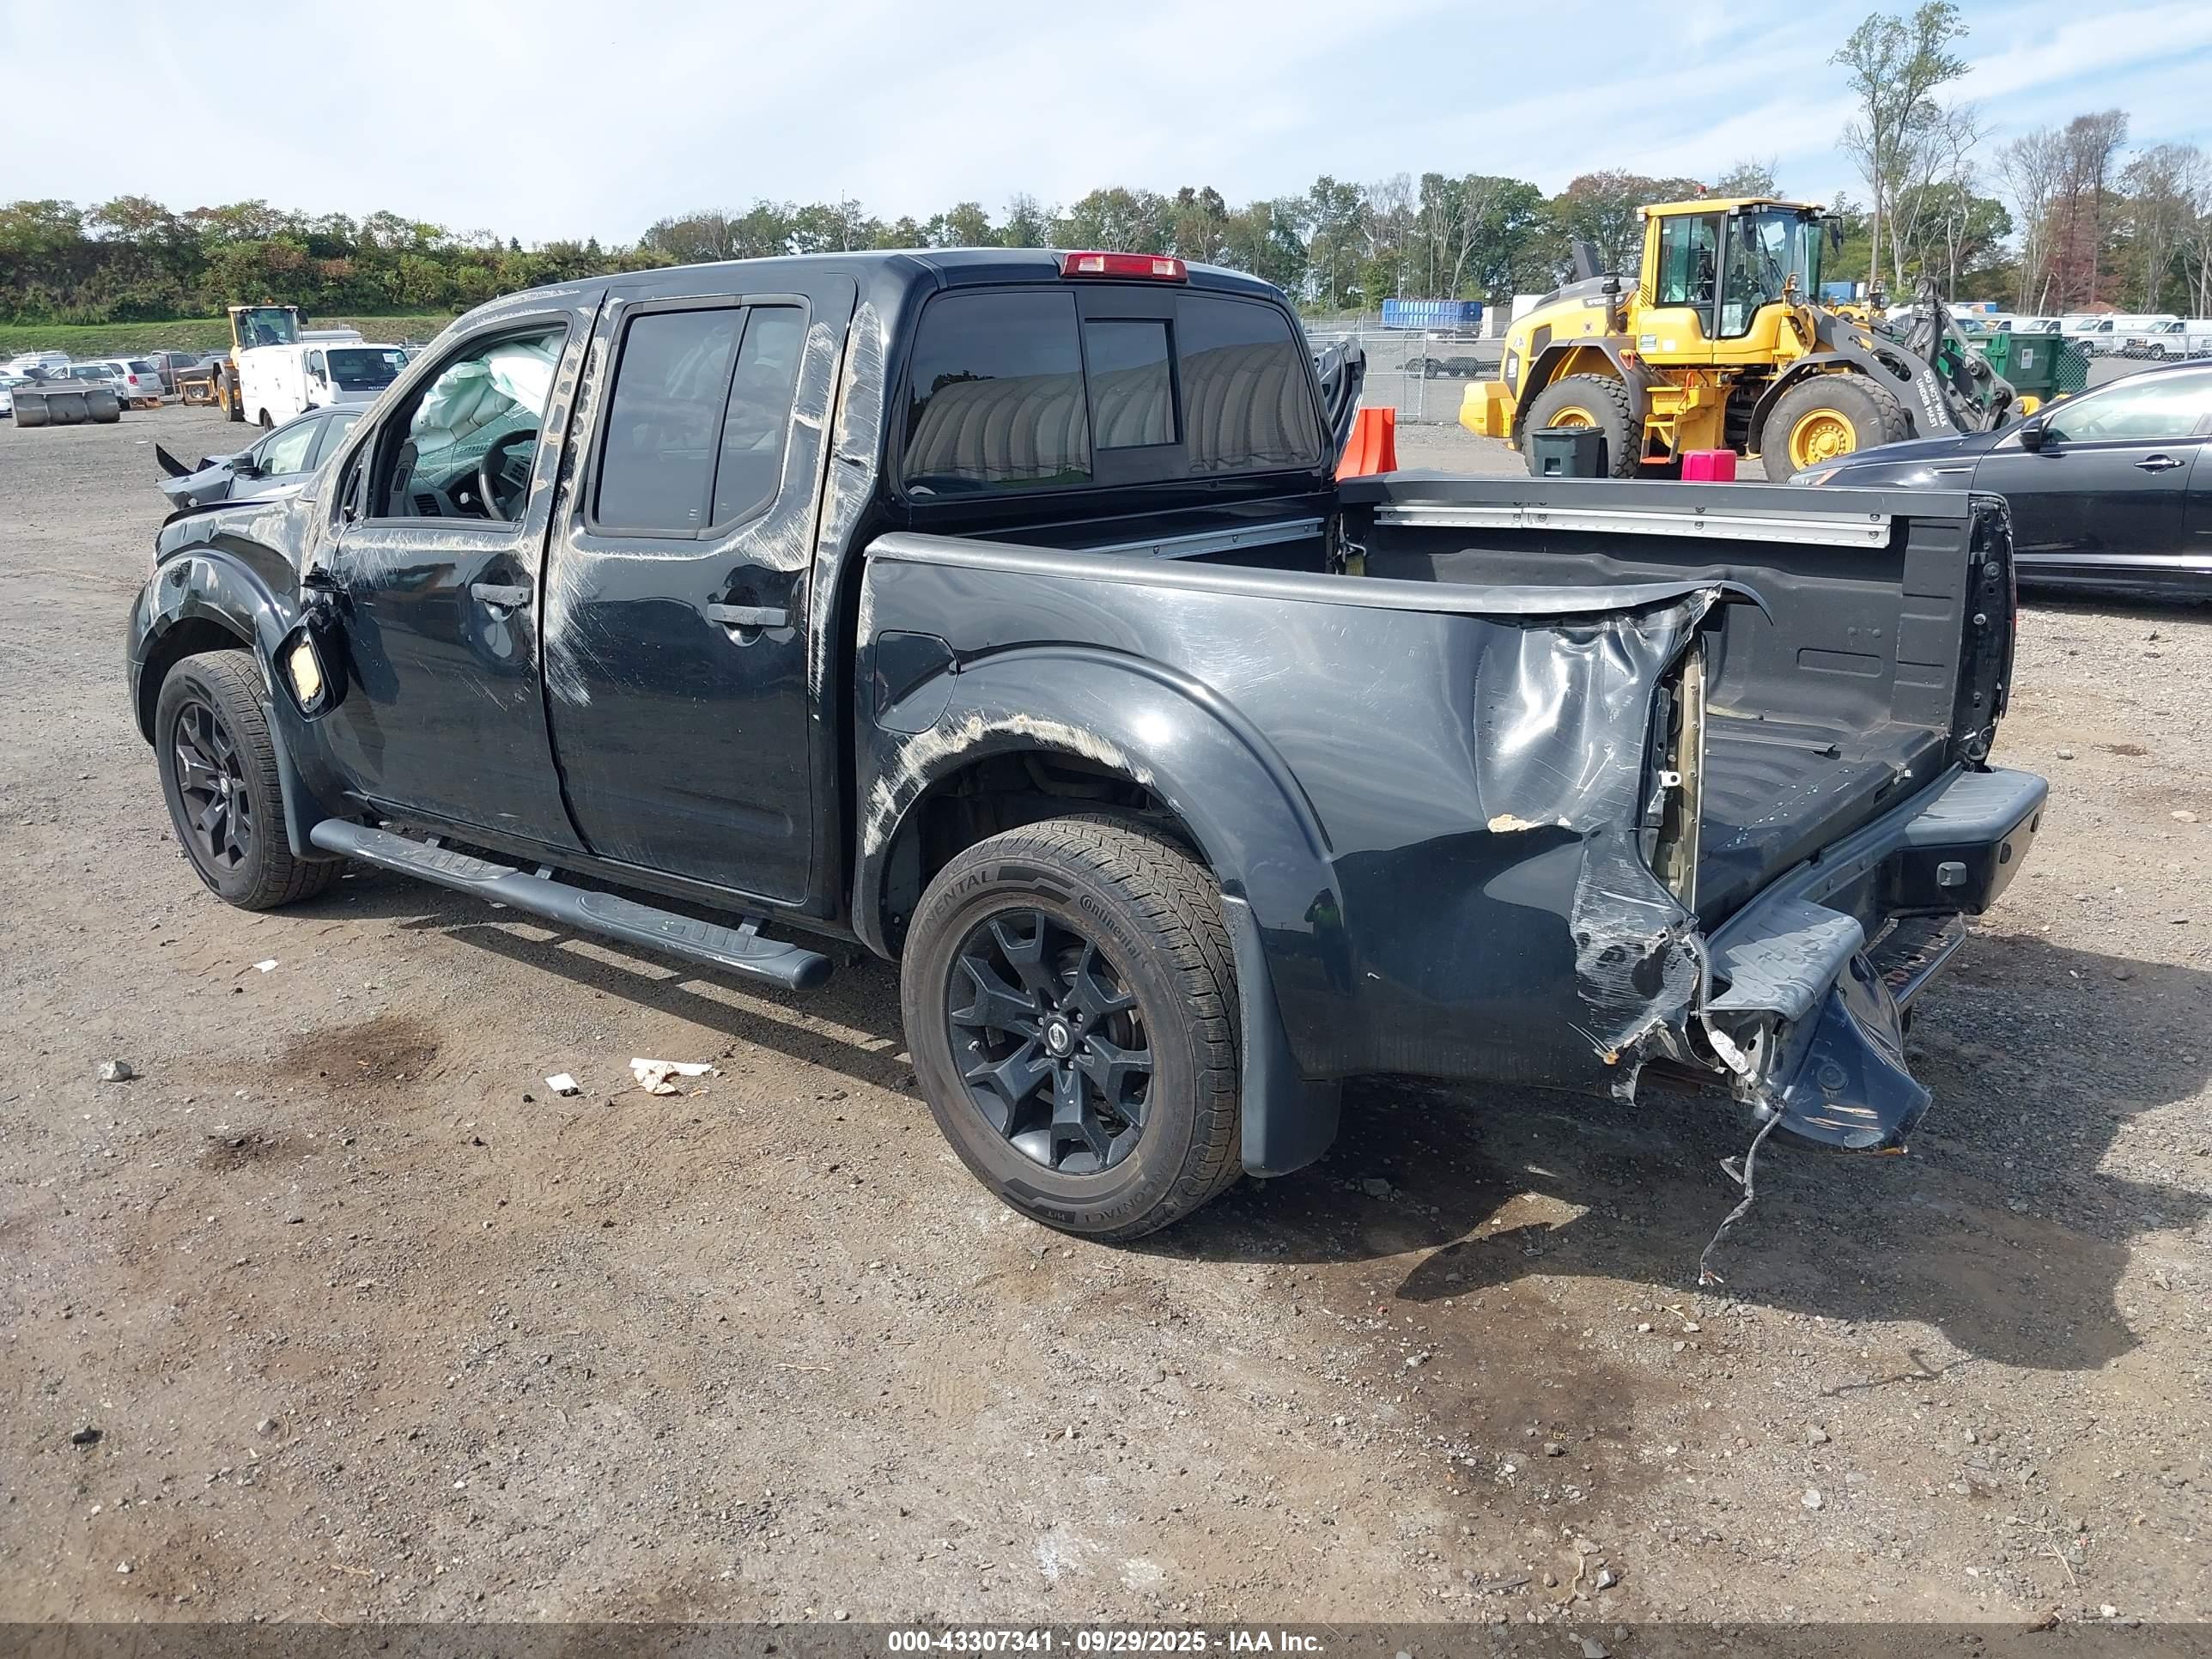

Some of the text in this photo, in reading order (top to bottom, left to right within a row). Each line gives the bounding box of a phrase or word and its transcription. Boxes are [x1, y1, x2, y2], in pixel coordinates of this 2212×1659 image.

[1586, 295, 1624, 306] VOLO
[1916, 378, 1938, 428] UNDER MAST
[1923, 369, 1948, 428] DO NOT WALK
[1079, 893, 1142, 960] Continental
